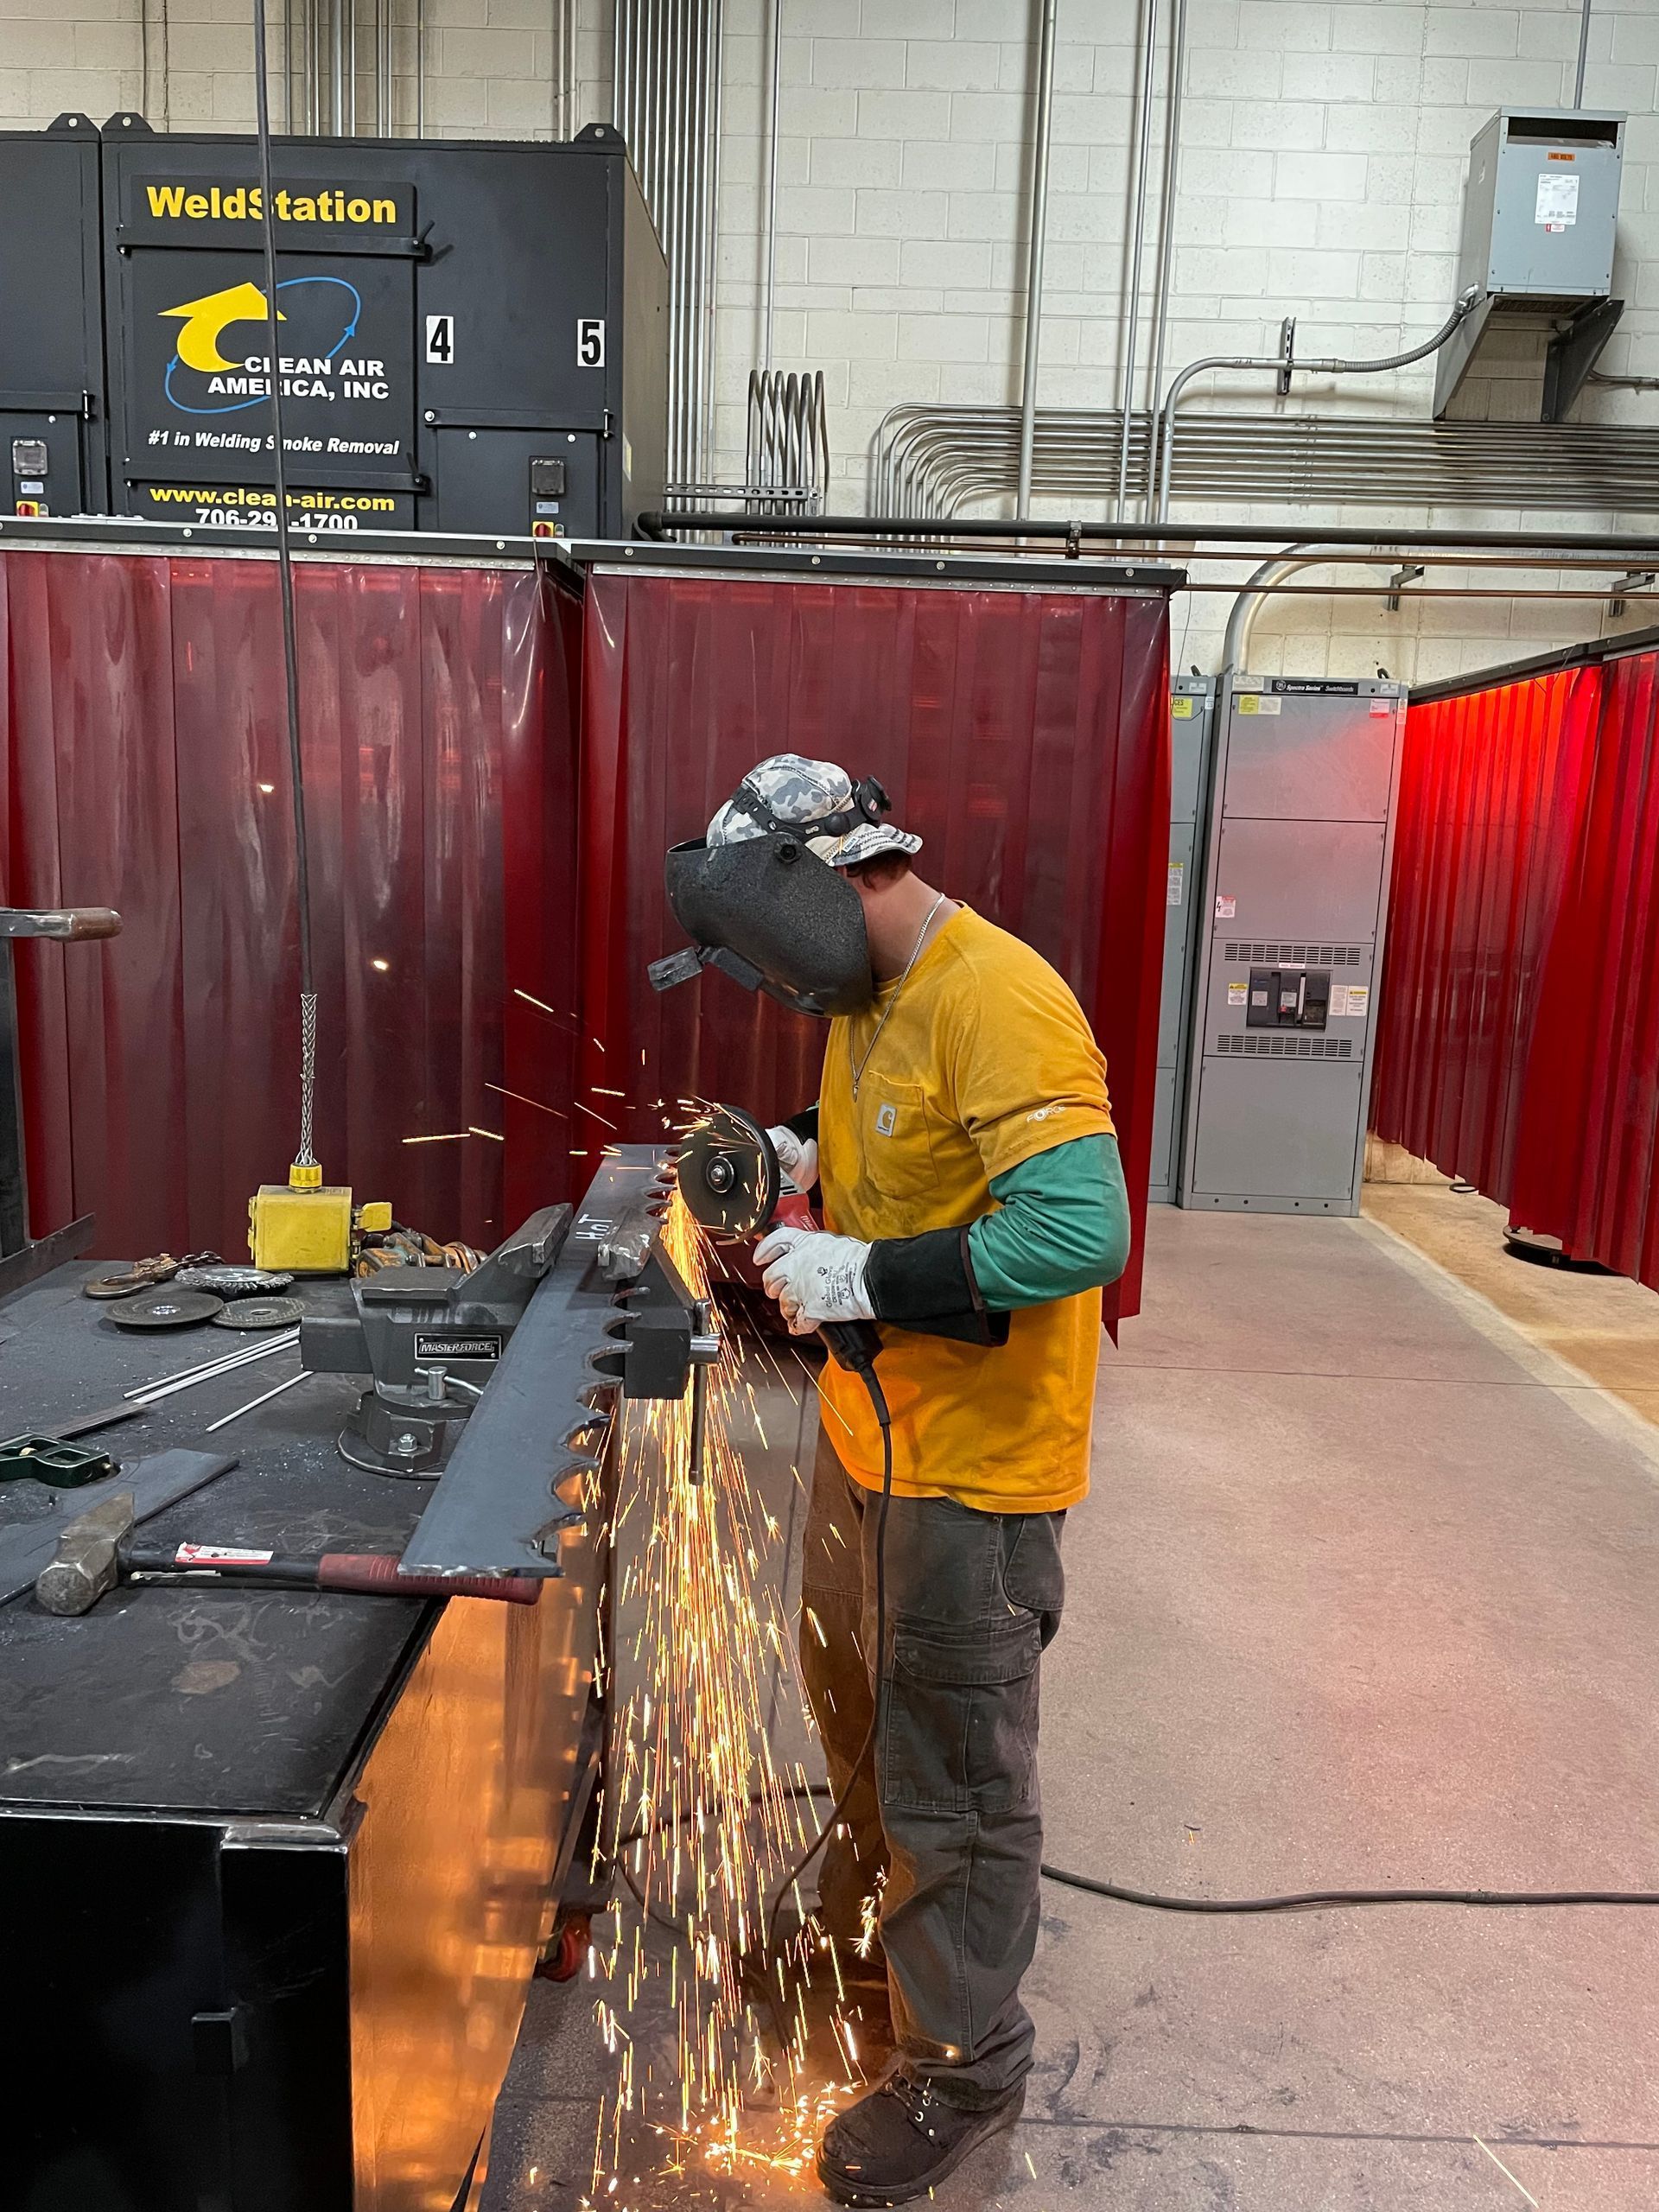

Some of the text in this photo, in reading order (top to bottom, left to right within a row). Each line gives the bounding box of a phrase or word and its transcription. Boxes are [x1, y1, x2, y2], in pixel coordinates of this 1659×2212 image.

[146, 186, 397, 223] WeldStation
[429, 318, 451, 362] 4
[582, 321, 601, 365] 5
[339, 359, 385, 377] AIR
[343, 381, 390, 399] INC
[148, 430, 170, 446] #1
[174, 431, 191, 447] in
[194, 432, 262, 453] Welding
[327, 437, 400, 455] Removal
[195, 508, 359, 530] 706-29-1700
[824, 1286, 833, 1308] Global
